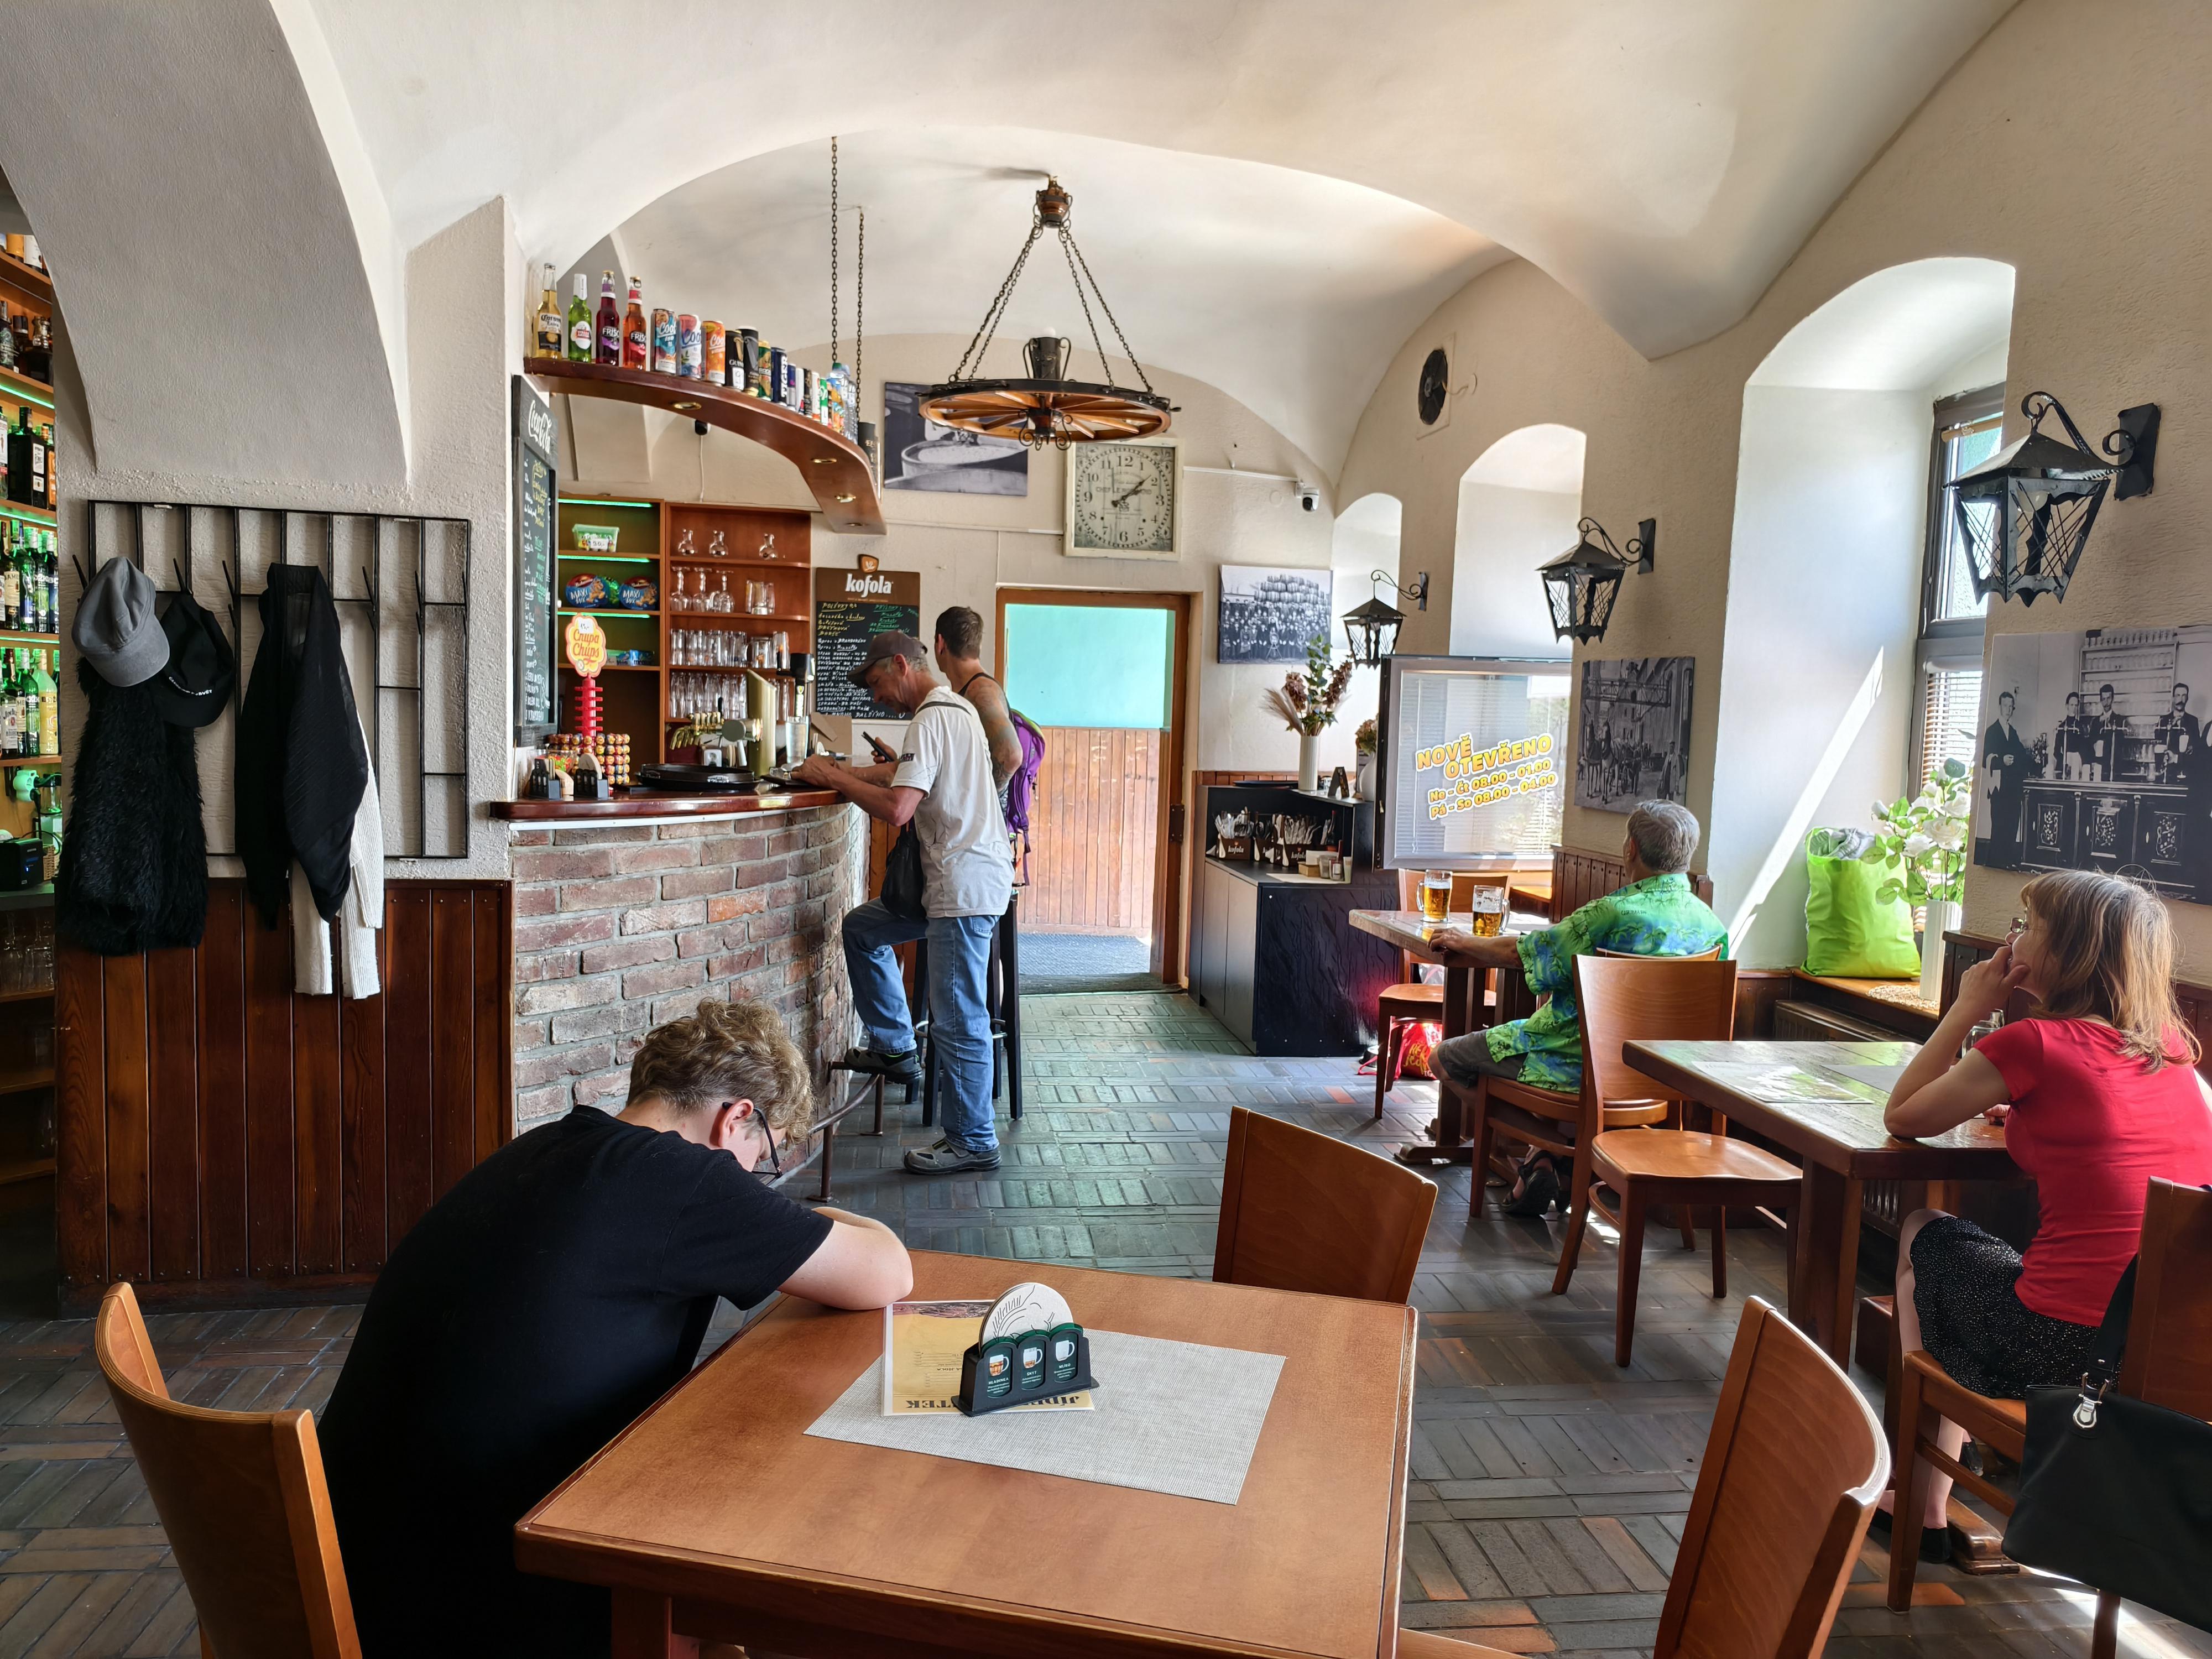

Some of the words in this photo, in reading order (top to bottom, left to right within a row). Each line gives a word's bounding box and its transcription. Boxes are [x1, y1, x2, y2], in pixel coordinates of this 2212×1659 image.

[603, 327, 620, 337] FRISC
[683, 330, 701, 345] Coo
[709, 336, 725, 347] Coo
[1102, 461, 1111, 469] 11
[1117, 456, 1133, 467] 12
[1140, 462, 1144, 471] 1
[1087, 473, 1099, 482] 10
[1151, 478, 1158, 486] 2
[1084, 492, 1092, 503] 9
[1156, 495, 1164, 507] 3
[1089, 512, 1097, 520] 8
[1151, 515, 1158, 524] 4
[1103, 526, 1108, 536] 7
[1120, 531, 1128, 542] 6
[1138, 528, 1144, 536] 5
[845, 573, 892, 598] kofola
[573, 643, 599, 660] Chups
[1417, 734, 1472, 769] NOVĚ
[1445, 735, 1552, 778] OTEVŘENO
[1430, 790, 1446, 802] Ne
[1456, 780, 1469, 794] Čt
[1472, 771, 1507, 790] 08.00
[1517, 759, 1551, 778] 01.00
[1431, 804, 1447, 817] Pá
[1457, 799, 1472, 811] So
[1474, 787, 1510, 805] 08.00
[1520, 774, 1555, 792] 04.00
[1291, 851, 1306, 860] kofol
